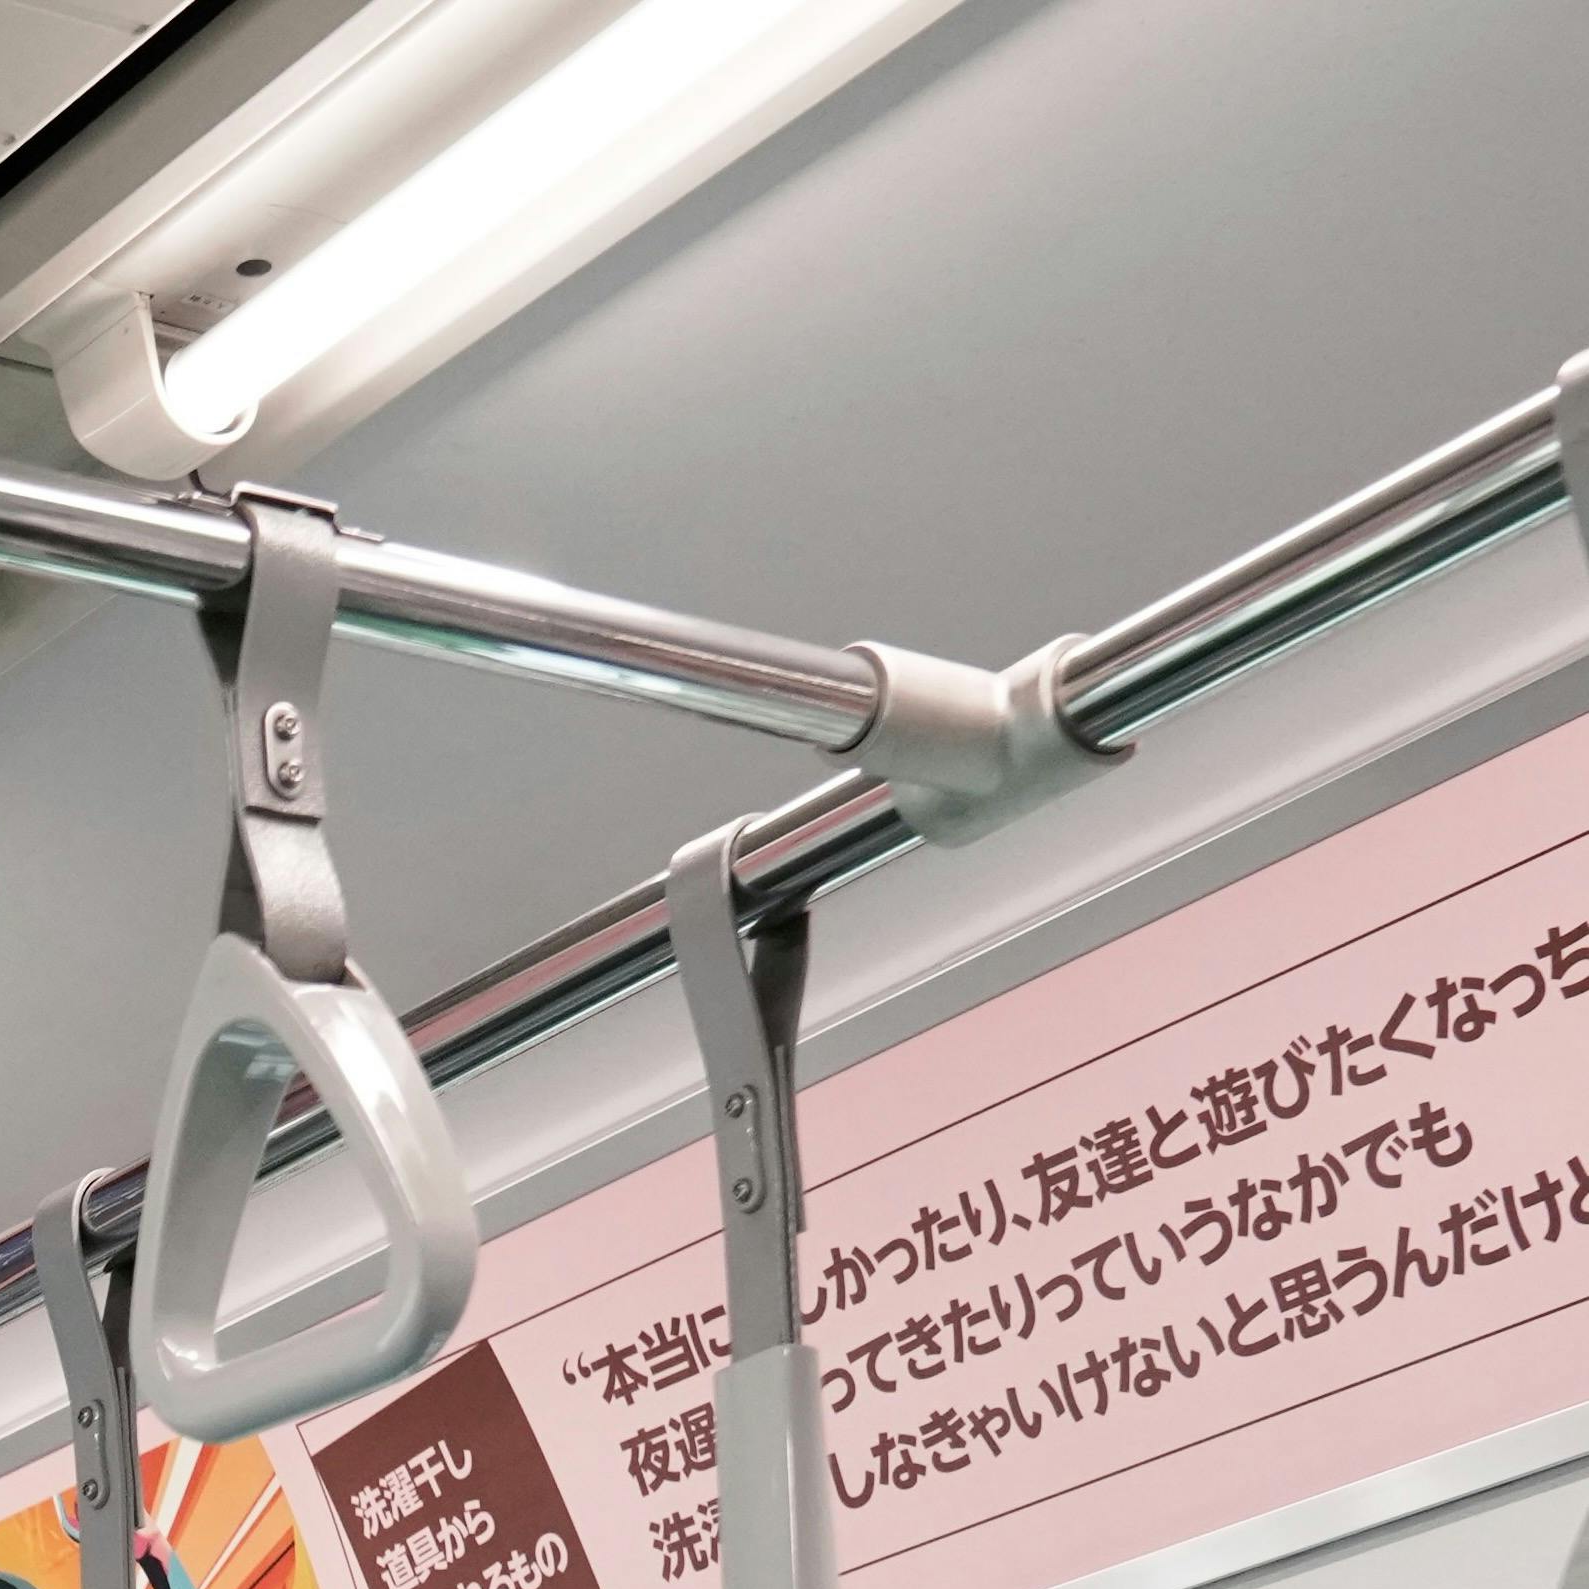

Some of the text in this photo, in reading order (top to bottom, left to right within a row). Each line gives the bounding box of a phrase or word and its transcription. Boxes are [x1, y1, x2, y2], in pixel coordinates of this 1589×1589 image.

[619, 1101, 1473, 1498] 夜遅ってきたりっていうなかでも
[350, 1439, 473, 1540] 洗濯干し
